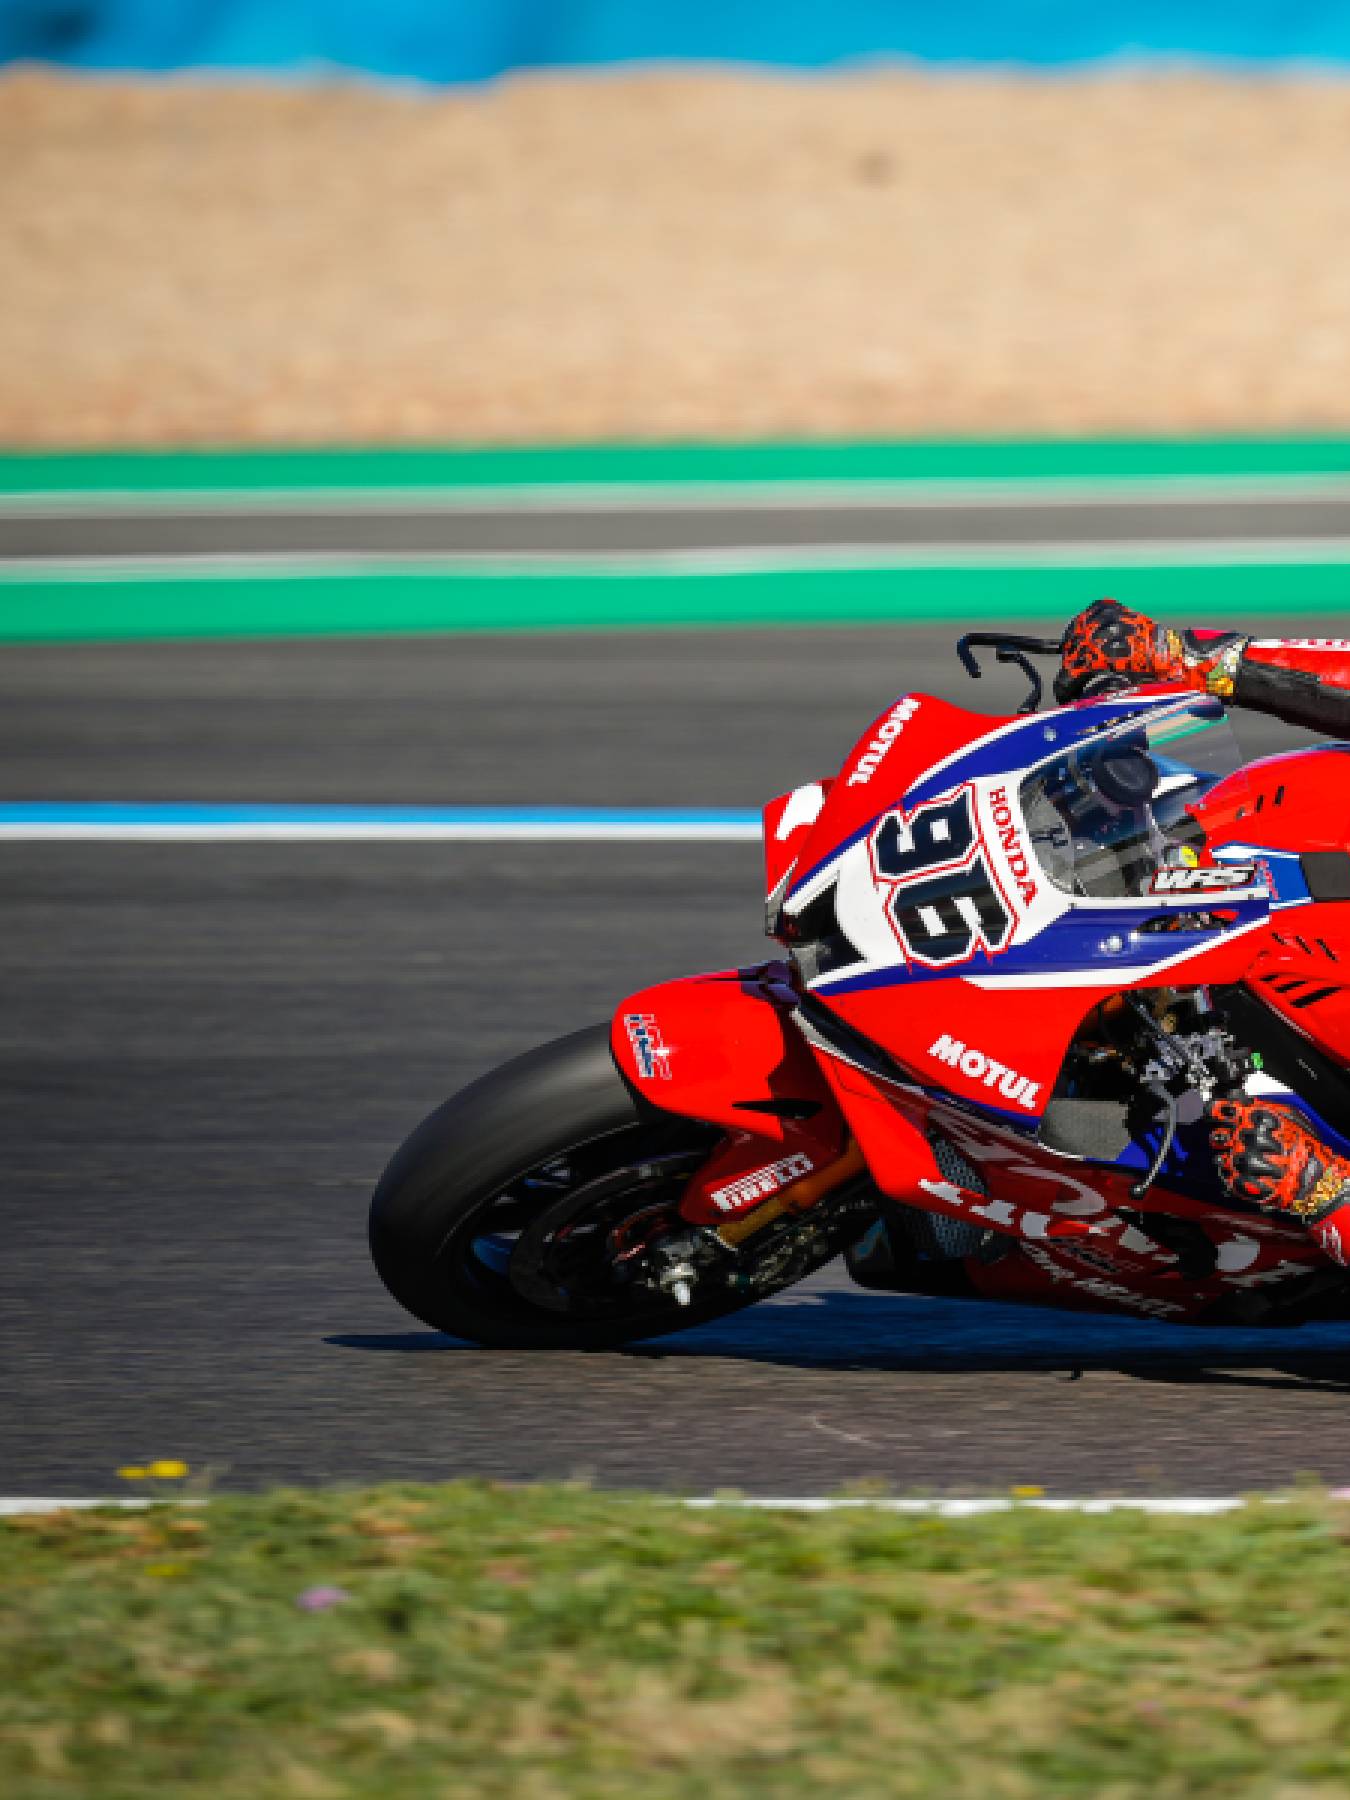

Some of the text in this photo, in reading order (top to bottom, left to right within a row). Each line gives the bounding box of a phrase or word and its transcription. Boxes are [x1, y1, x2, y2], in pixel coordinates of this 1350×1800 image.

[846, 697, 921, 787] MOTUL
[870, 784, 1018, 970] 96
[988, 785, 1039, 909] HONDA
[1152, 865, 1257, 891] WRS
[927, 1033, 1045, 1109] MOTUL
[710, 1151, 814, 1212] PIRELLI
